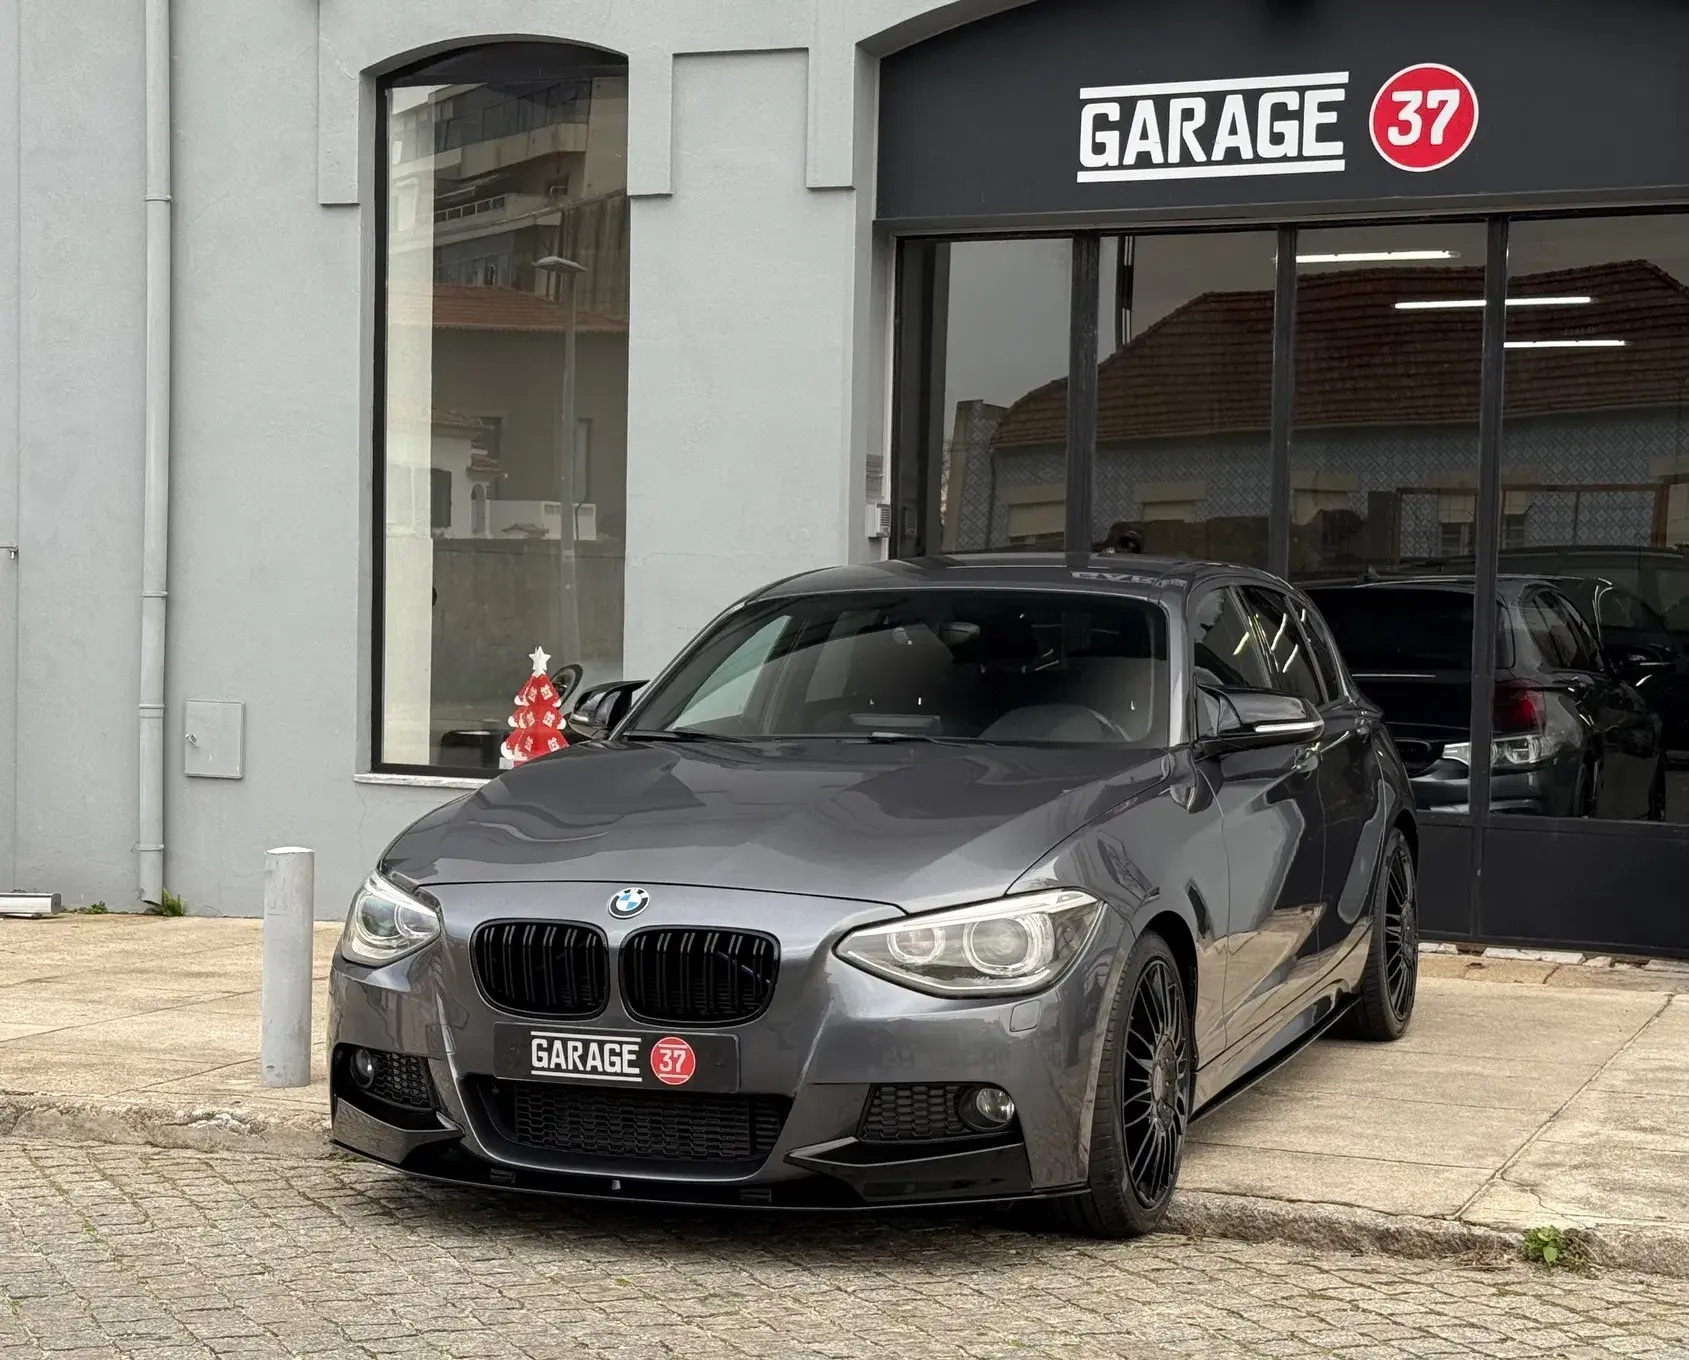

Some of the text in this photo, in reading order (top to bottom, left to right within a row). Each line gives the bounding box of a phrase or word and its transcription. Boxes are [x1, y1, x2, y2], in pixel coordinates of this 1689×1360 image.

[1079, 88, 1460, 168] GARAGE 37
[531, 1038, 687, 1075] GARAGE 37
